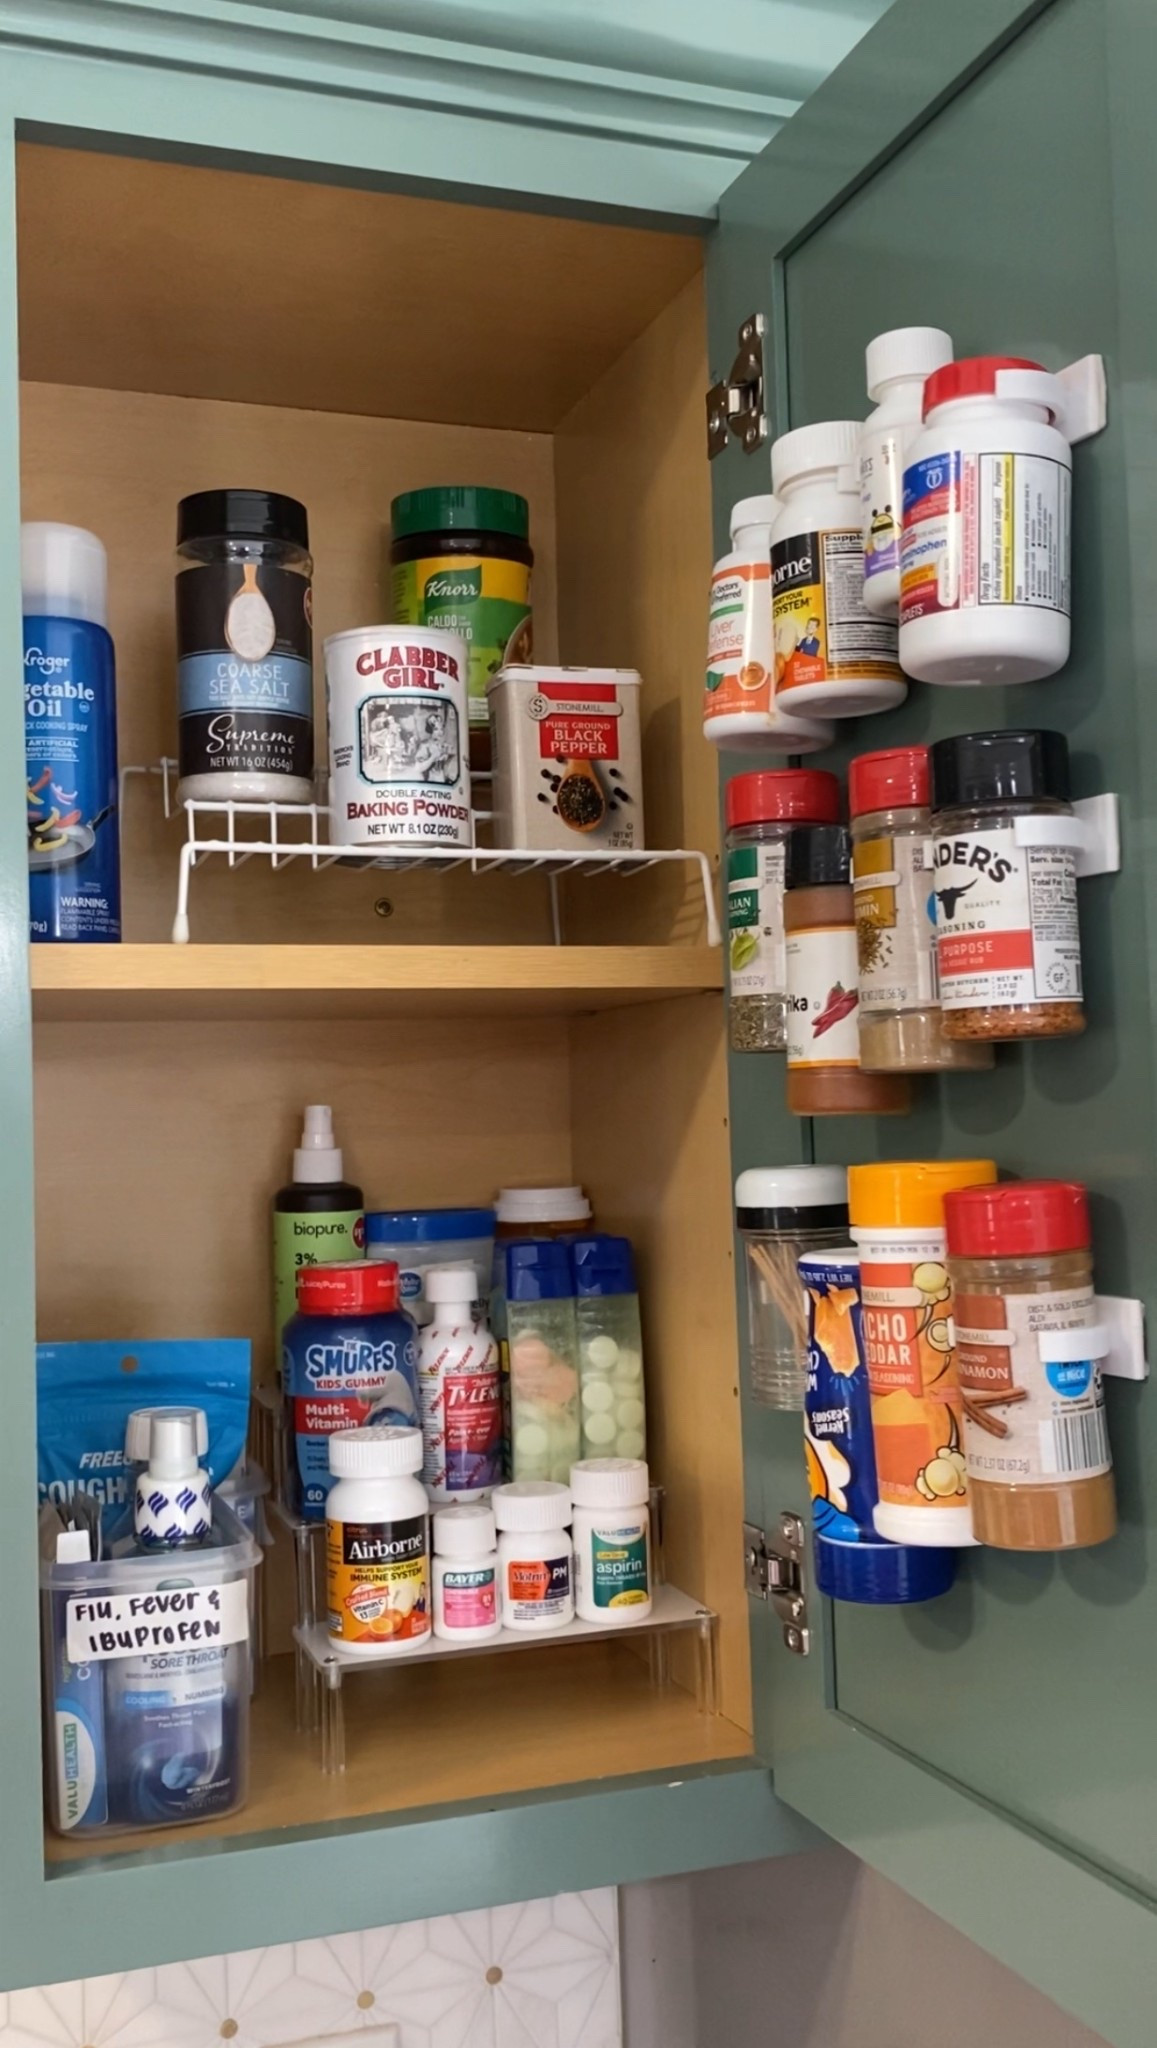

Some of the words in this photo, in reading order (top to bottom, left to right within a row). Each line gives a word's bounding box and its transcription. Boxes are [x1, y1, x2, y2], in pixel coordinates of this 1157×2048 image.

[426, 580, 478, 597] Knorr
[217, 662, 283, 681] COARSE
[356, 646, 460, 683] CLABBER
[209, 679, 242, 695] SEA
[250, 680, 290, 697] SALT
[383, 669, 440, 691] GIRL
[28, 700, 62, 717] Oil
[206, 713, 295, 754] Supreme
[545, 720, 570, 730] PURE
[571, 721, 611, 731] GROUND
[553, 729, 603, 743] BLACK
[550, 741, 608, 755] PEPPER
[210, 757, 225, 767] NET
[226, 757, 239, 767] WT
[254, 757, 266, 768] OZ
[376, 790, 417, 798] DOUBLE
[420, 790, 452, 800] ACTING
[347, 802, 409, 820] BAKING
[413, 799, 469, 822] POWDER
[368, 824, 387, 836] NET
[389, 824, 405, 835] WT
[408, 824, 420, 834] 8.1
[423, 824, 437, 835] OZ
[306, 1341, 396, 1379] SMURFS
[316, 1379, 342, 1389] KIDS
[344, 1376, 387, 1388] GUMMY
[305, 1404, 350, 1416] Multi-
[305, 1417, 358, 1430] Vitamin
[307, 1490, 324, 1501] 60
[348, 1533, 422, 1560] Airborne
[350, 1573, 389, 1583] IMMUNE
[390, 1565, 422, 1582] SYSTEM
[354, 1566, 374, 1574] HELPS
[375, 1562, 404, 1573] SUPPORT
[596, 1557, 642, 1577] aspirin
[445, 1572, 484, 1584] BAYER
[151, 1657, 184, 1670] SORE
[185, 1647, 229, 1667] THROAT
